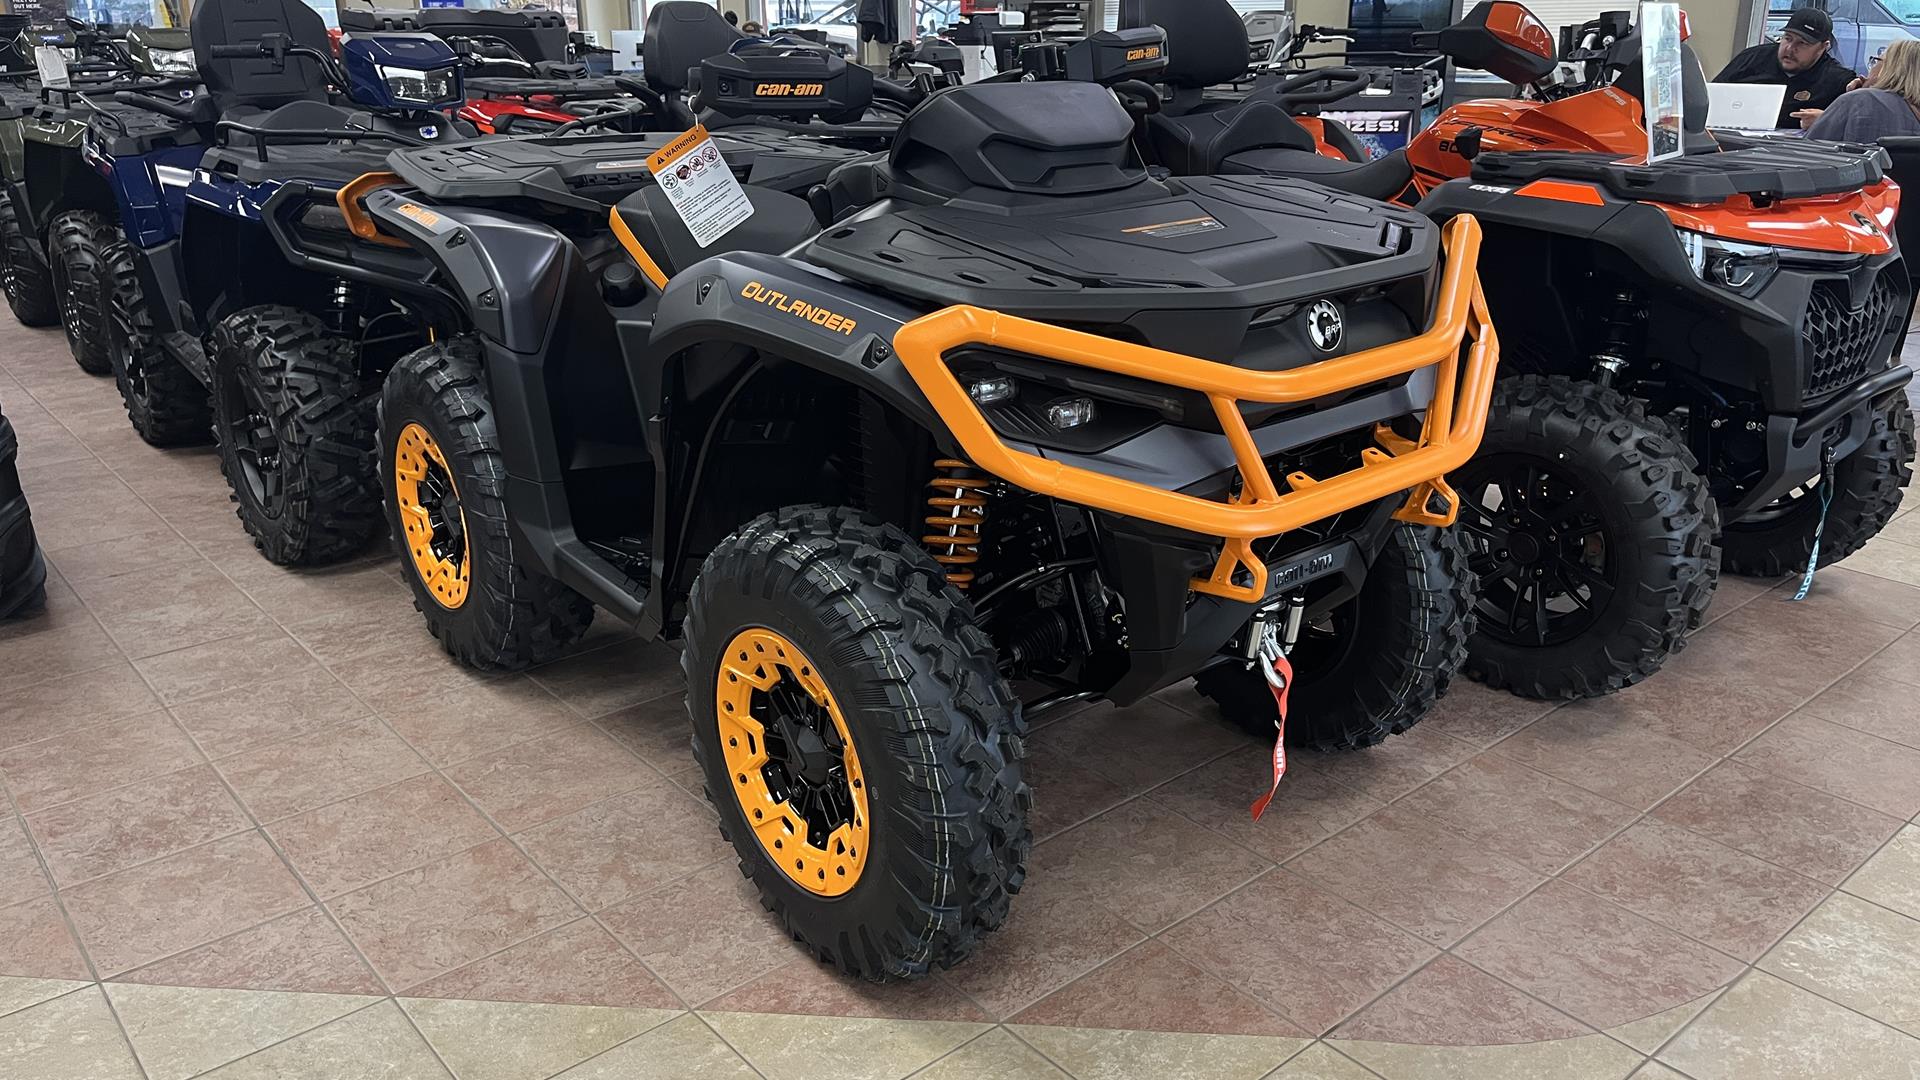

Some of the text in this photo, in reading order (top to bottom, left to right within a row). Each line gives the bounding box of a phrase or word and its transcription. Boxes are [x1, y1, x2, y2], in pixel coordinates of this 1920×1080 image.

[1126, 47, 1160, 61] can-am
[755, 83, 823, 96] can-am
[1344, 120, 1400, 133] IZES!
[664, 133, 698, 159] WARNING
[741, 281, 858, 336] OUTLANDER
